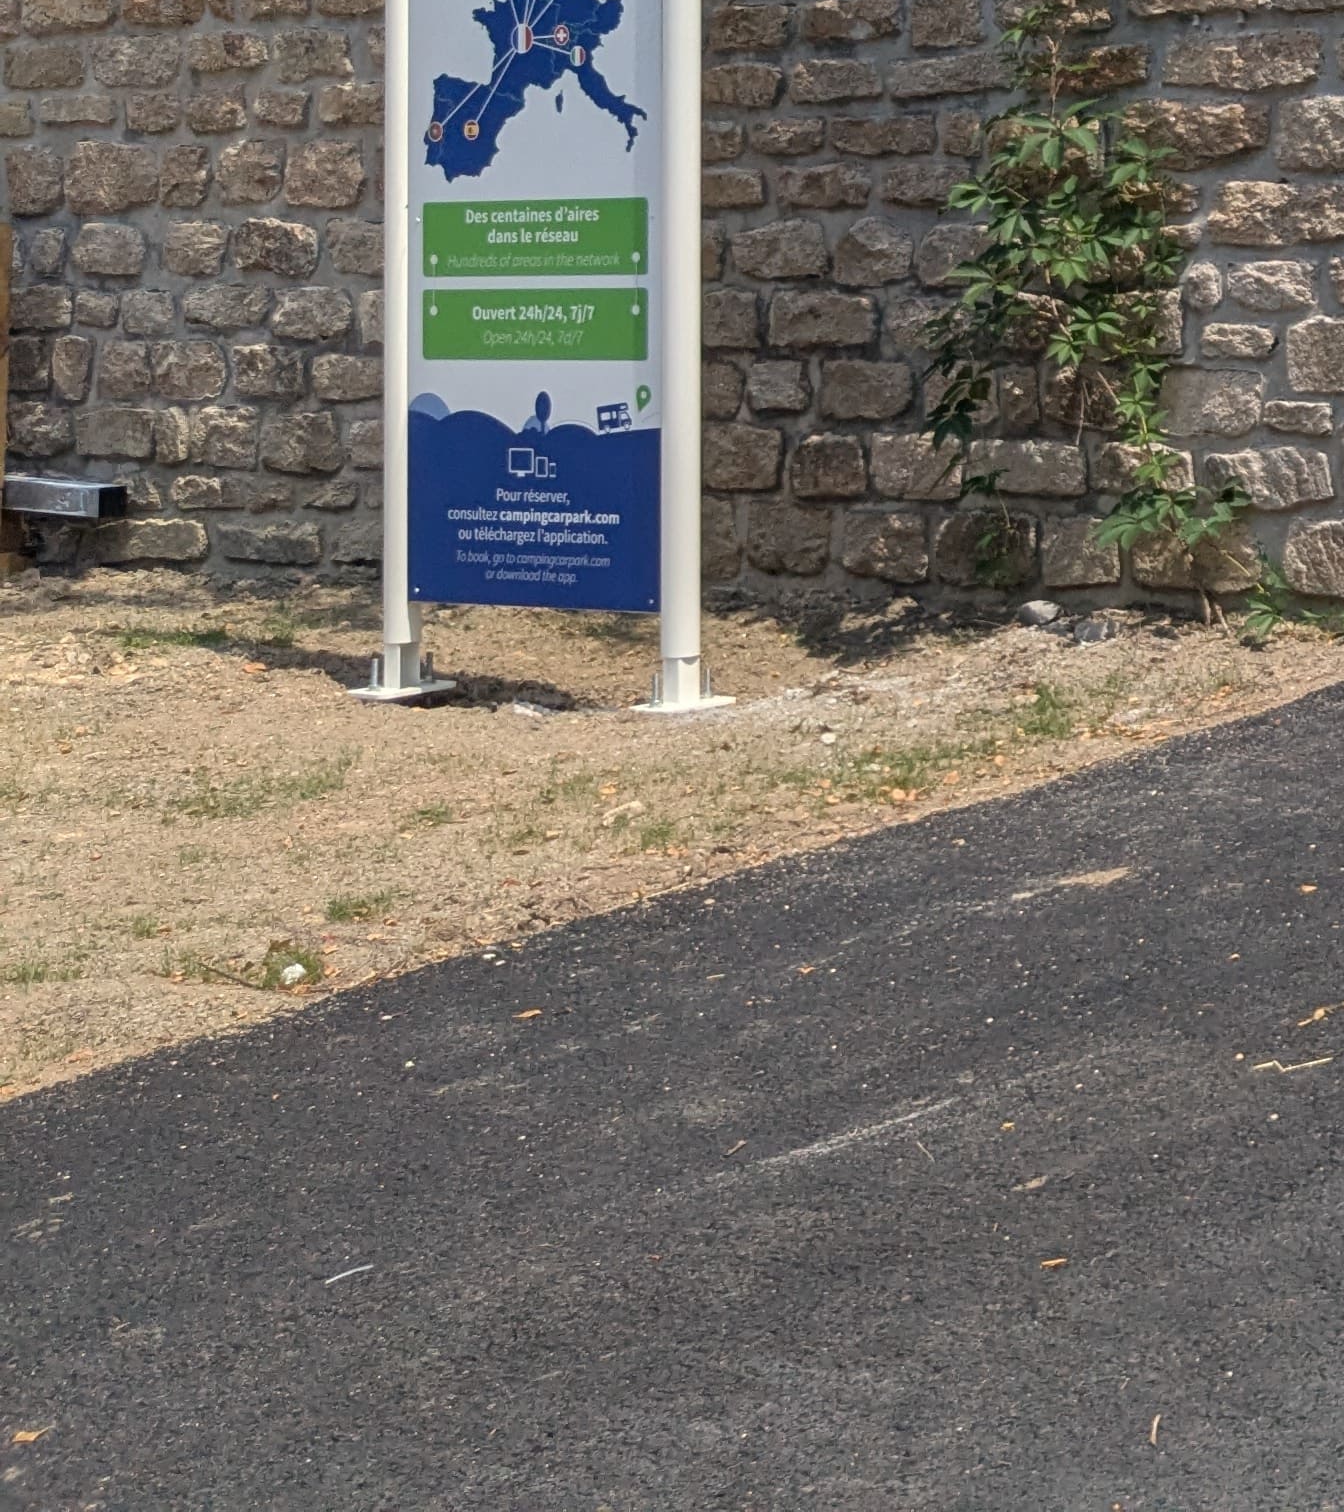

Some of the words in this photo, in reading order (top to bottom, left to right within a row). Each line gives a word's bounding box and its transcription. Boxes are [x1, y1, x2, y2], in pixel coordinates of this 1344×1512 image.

[466, 209, 488, 224] Des
[491, 208, 552, 223] centaines
[555, 207, 599, 222] d'aires
[488, 230, 518, 244] dans
[521, 229, 533, 243] le
[536, 228, 579, 243] réseau
[448, 255, 497, 268] Hundreds
[499, 253, 512, 267] of
[556, 253, 574, 266] the
[576, 252, 620, 266] network
[472, 306, 516, 320] Ouvert
[519, 306, 567, 323] 24h/24,
[570, 306, 595, 324] 7j/7
[483, 330, 512, 347] Open
[514, 330, 555, 345] 24h/24,
[558, 330, 583, 344] 7d/7
[496, 488, 521, 502] Pour
[524, 489, 570, 505] réserver,
[448, 507, 498, 521] consultez
[500, 509, 620, 527] campingcarpark.com
[458, 530, 472, 541] ou
[474, 527, 535, 545] téléchargez
[537, 529, 608, 546] l'application.
[456, 551, 466, 561] To
[467, 550, 491, 564] book,
[493, 553, 505, 566] go
[506, 552, 515, 563] to
[516, 553, 610, 567] campingcarpark.com
[485, 570, 495, 580] or
[496, 568, 540, 581] download
[542, 569, 556, 582] the
